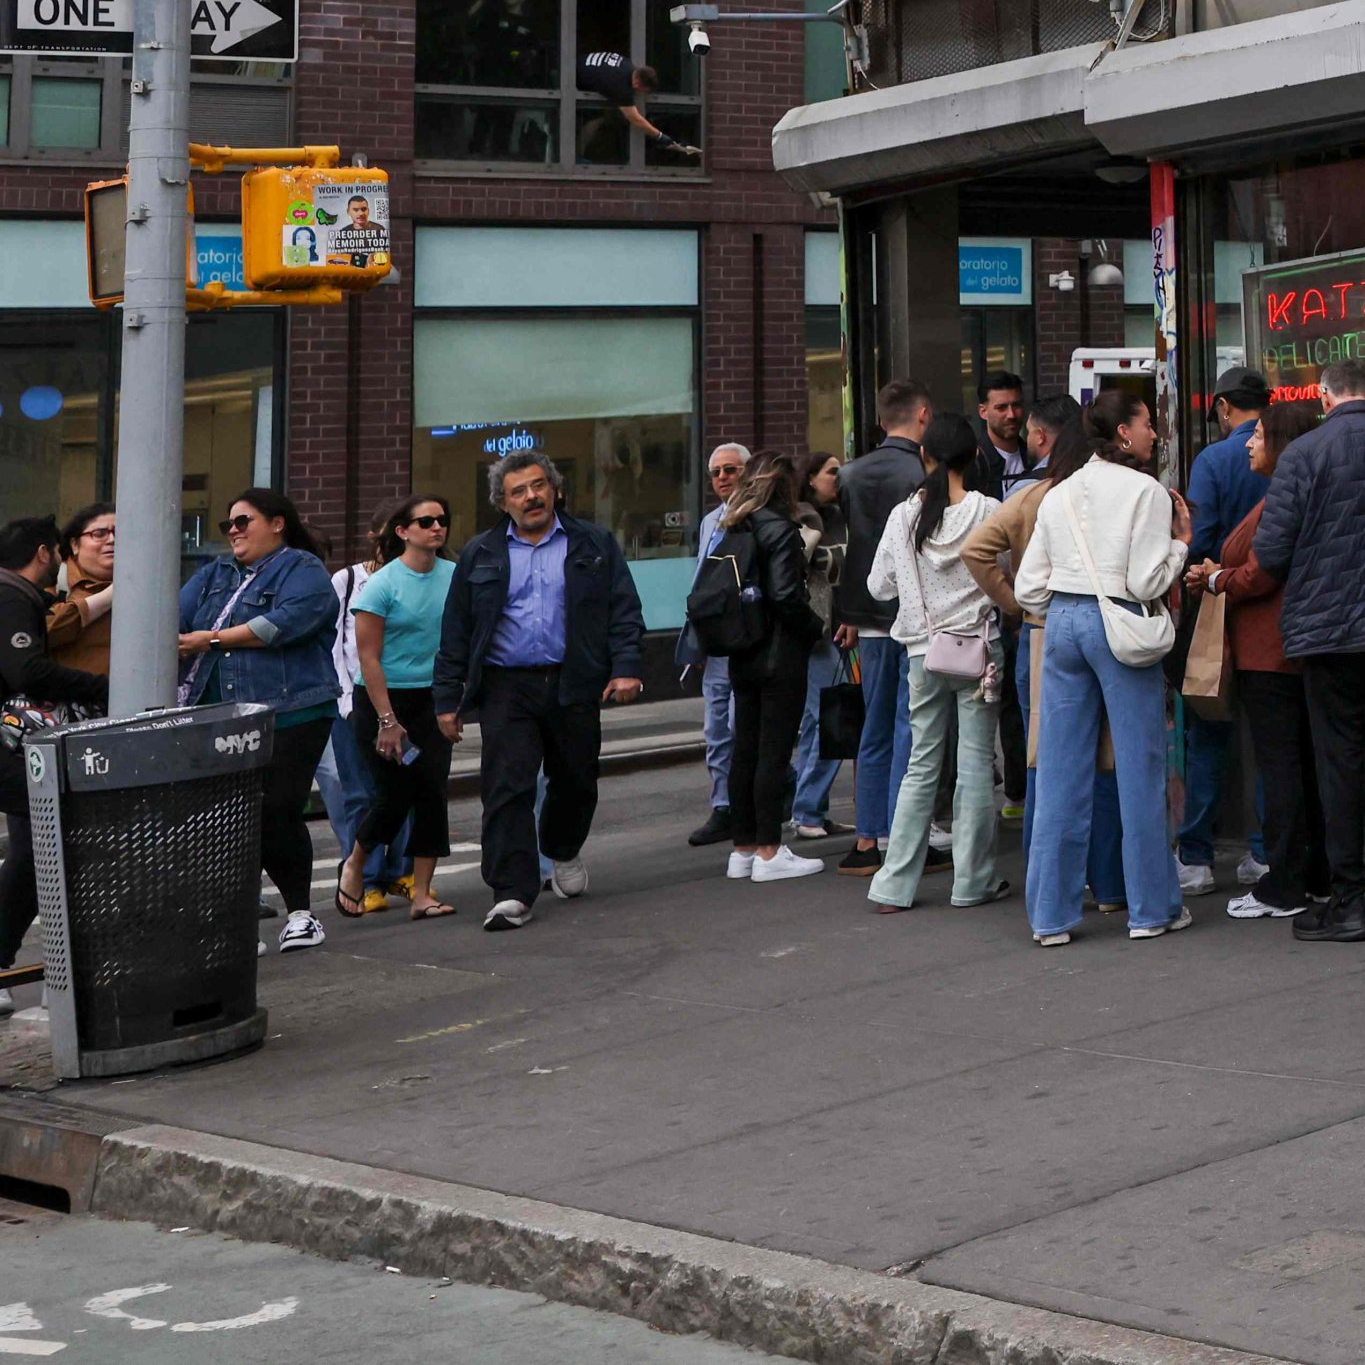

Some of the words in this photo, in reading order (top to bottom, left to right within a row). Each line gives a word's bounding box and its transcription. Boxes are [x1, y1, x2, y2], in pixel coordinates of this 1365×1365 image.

[191, 0, 242, 32] AY
[318, 186, 343, 195] WORK
[345, 186, 354, 194] IN
[329, 229, 377, 239] PREORDER
[327, 238, 365, 248] MEMOIR
[981, 274, 1019, 291] gelato
[152, 718, 174, 731] Don't
[174, 715, 194, 727] Litter
